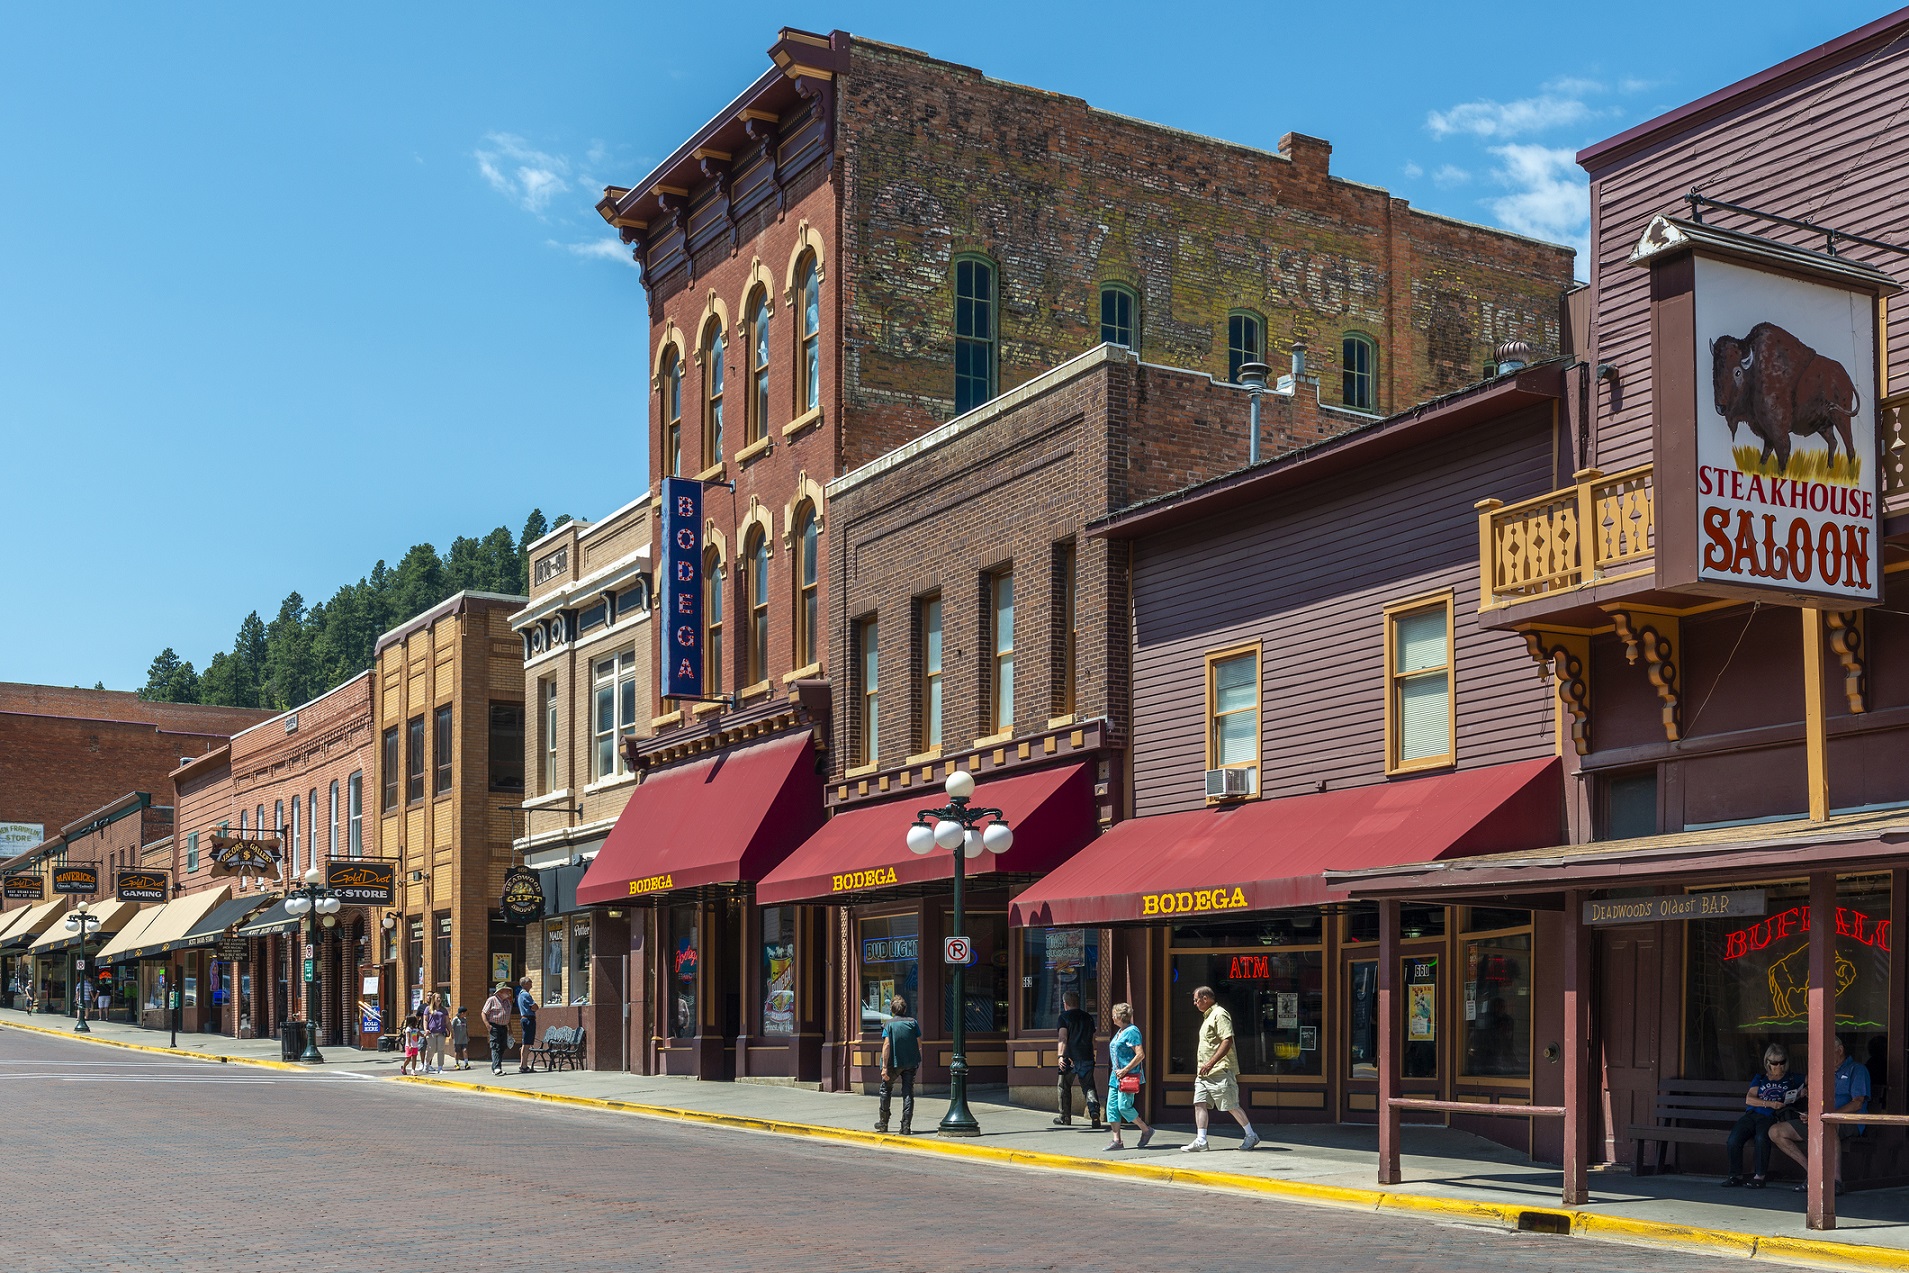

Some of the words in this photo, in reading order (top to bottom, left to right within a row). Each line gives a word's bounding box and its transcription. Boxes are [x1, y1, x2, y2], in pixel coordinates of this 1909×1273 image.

[1699, 465, 1874, 520] STEAKHOUSE
[1702, 505, 1872, 590] SALOON
[676, 495, 695, 679] BODEGA
[6, 834, 32, 842] STORE
[10, 825, 41, 837] FRANKLIN
[221, 842, 244, 863] JACOBS
[56, 871, 96, 883] MAVERICKS
[119, 875, 143, 887] Gold
[141, 876, 165, 888] Dust
[329, 867, 362, 884] Gold
[359, 868, 392, 884] Dust
[506, 874, 541, 892] DEADWOOD
[629, 874, 673, 895] BODEGA
[832, 866, 898, 892] BODEGA
[122, 889, 162, 898] GAMING
[506, 894, 542, 903] GIFT
[1142, 887, 1248, 915] BODEGA
[1592, 902, 1653, 921] DEADWOOD'S
[1660, 898, 1698, 916] Oldest
[1700, 895, 1730, 914] BAR
[865, 941, 888, 960] BUD
[1229, 956, 1270, 979] ATM
[1415, 964, 1430, 976] 660
